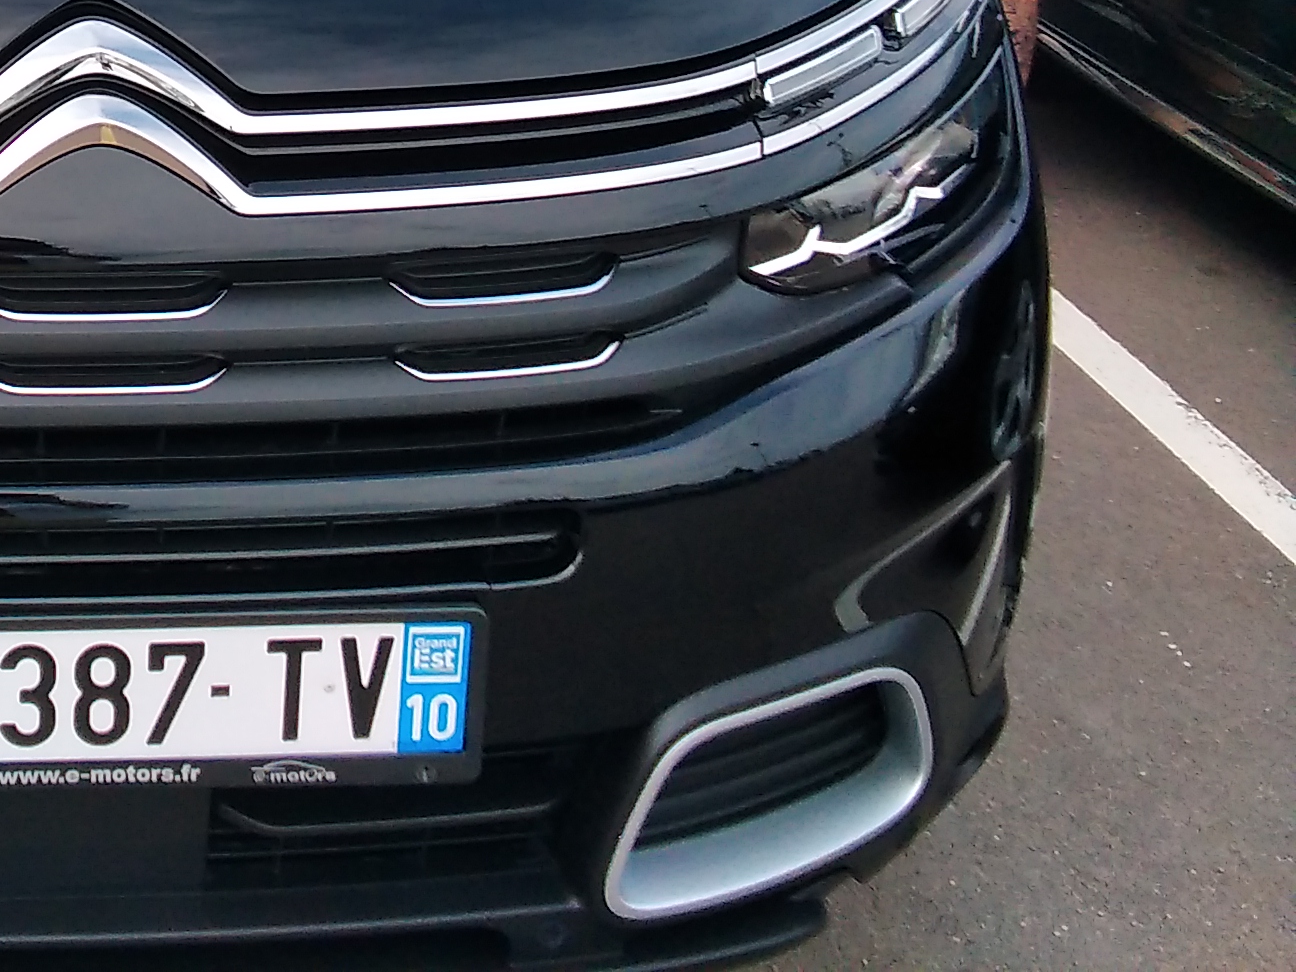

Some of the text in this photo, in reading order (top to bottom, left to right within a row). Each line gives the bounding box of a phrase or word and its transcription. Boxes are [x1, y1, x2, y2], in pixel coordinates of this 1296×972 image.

[413, 636, 458, 649] Grand
[413, 647, 456, 672] Est
[405, 692, 458, 742] 10
